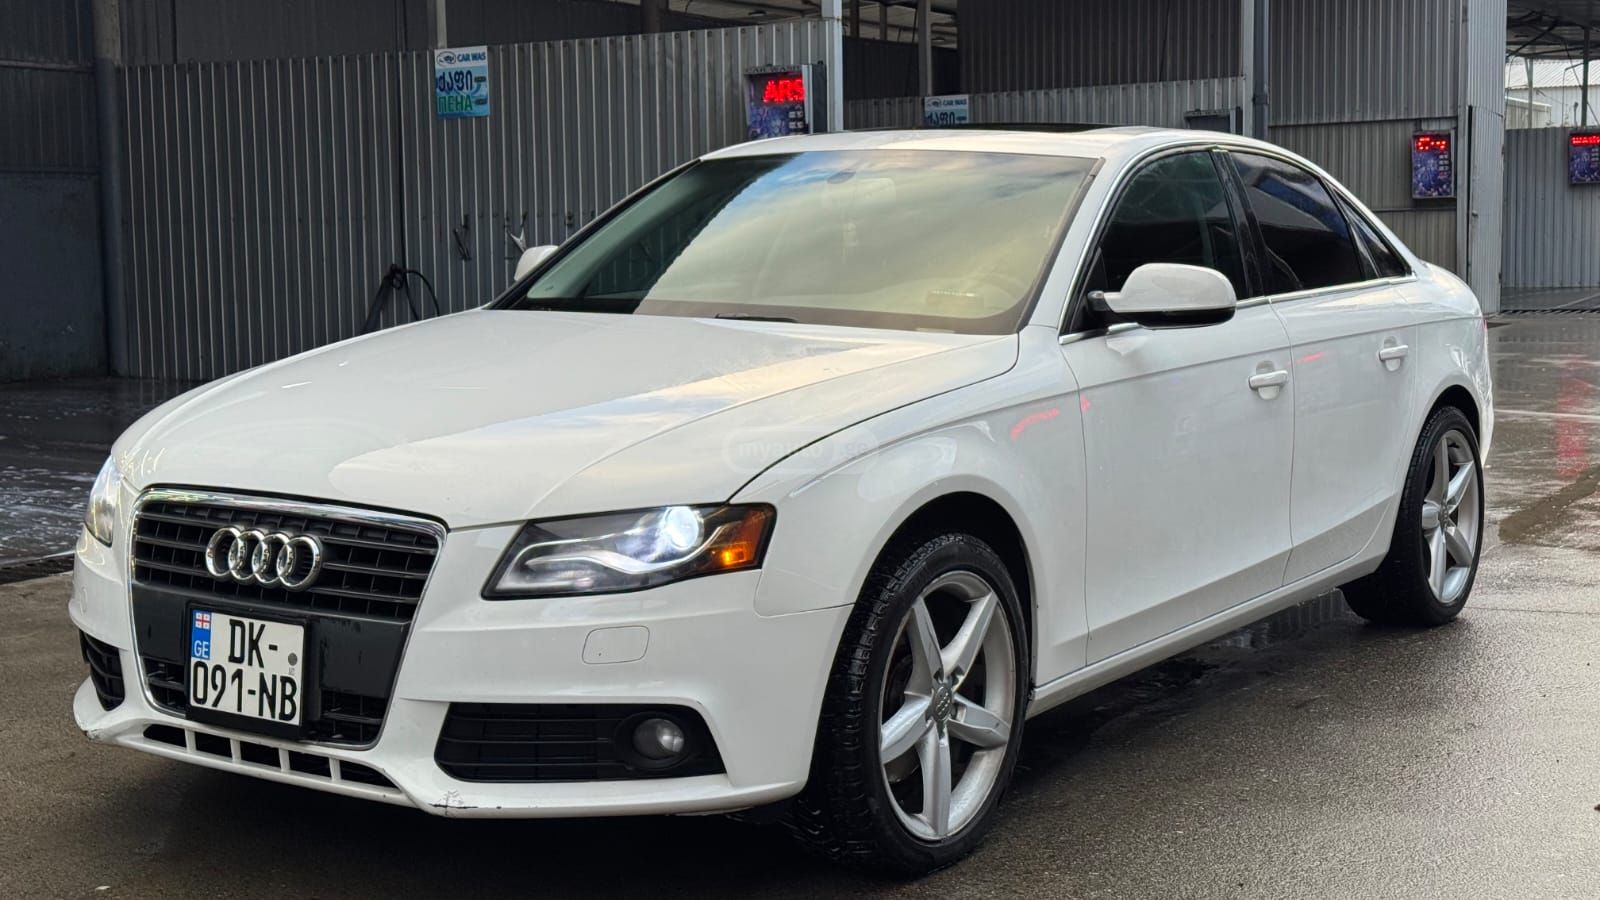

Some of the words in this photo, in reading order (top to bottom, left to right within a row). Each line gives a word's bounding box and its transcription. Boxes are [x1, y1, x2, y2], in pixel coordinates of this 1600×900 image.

[457, 52, 470, 62] CAR
[438, 95, 473, 112] ПЕНА
[194, 640, 209, 659] GE
[193, 660, 297, 721] 091-NB
